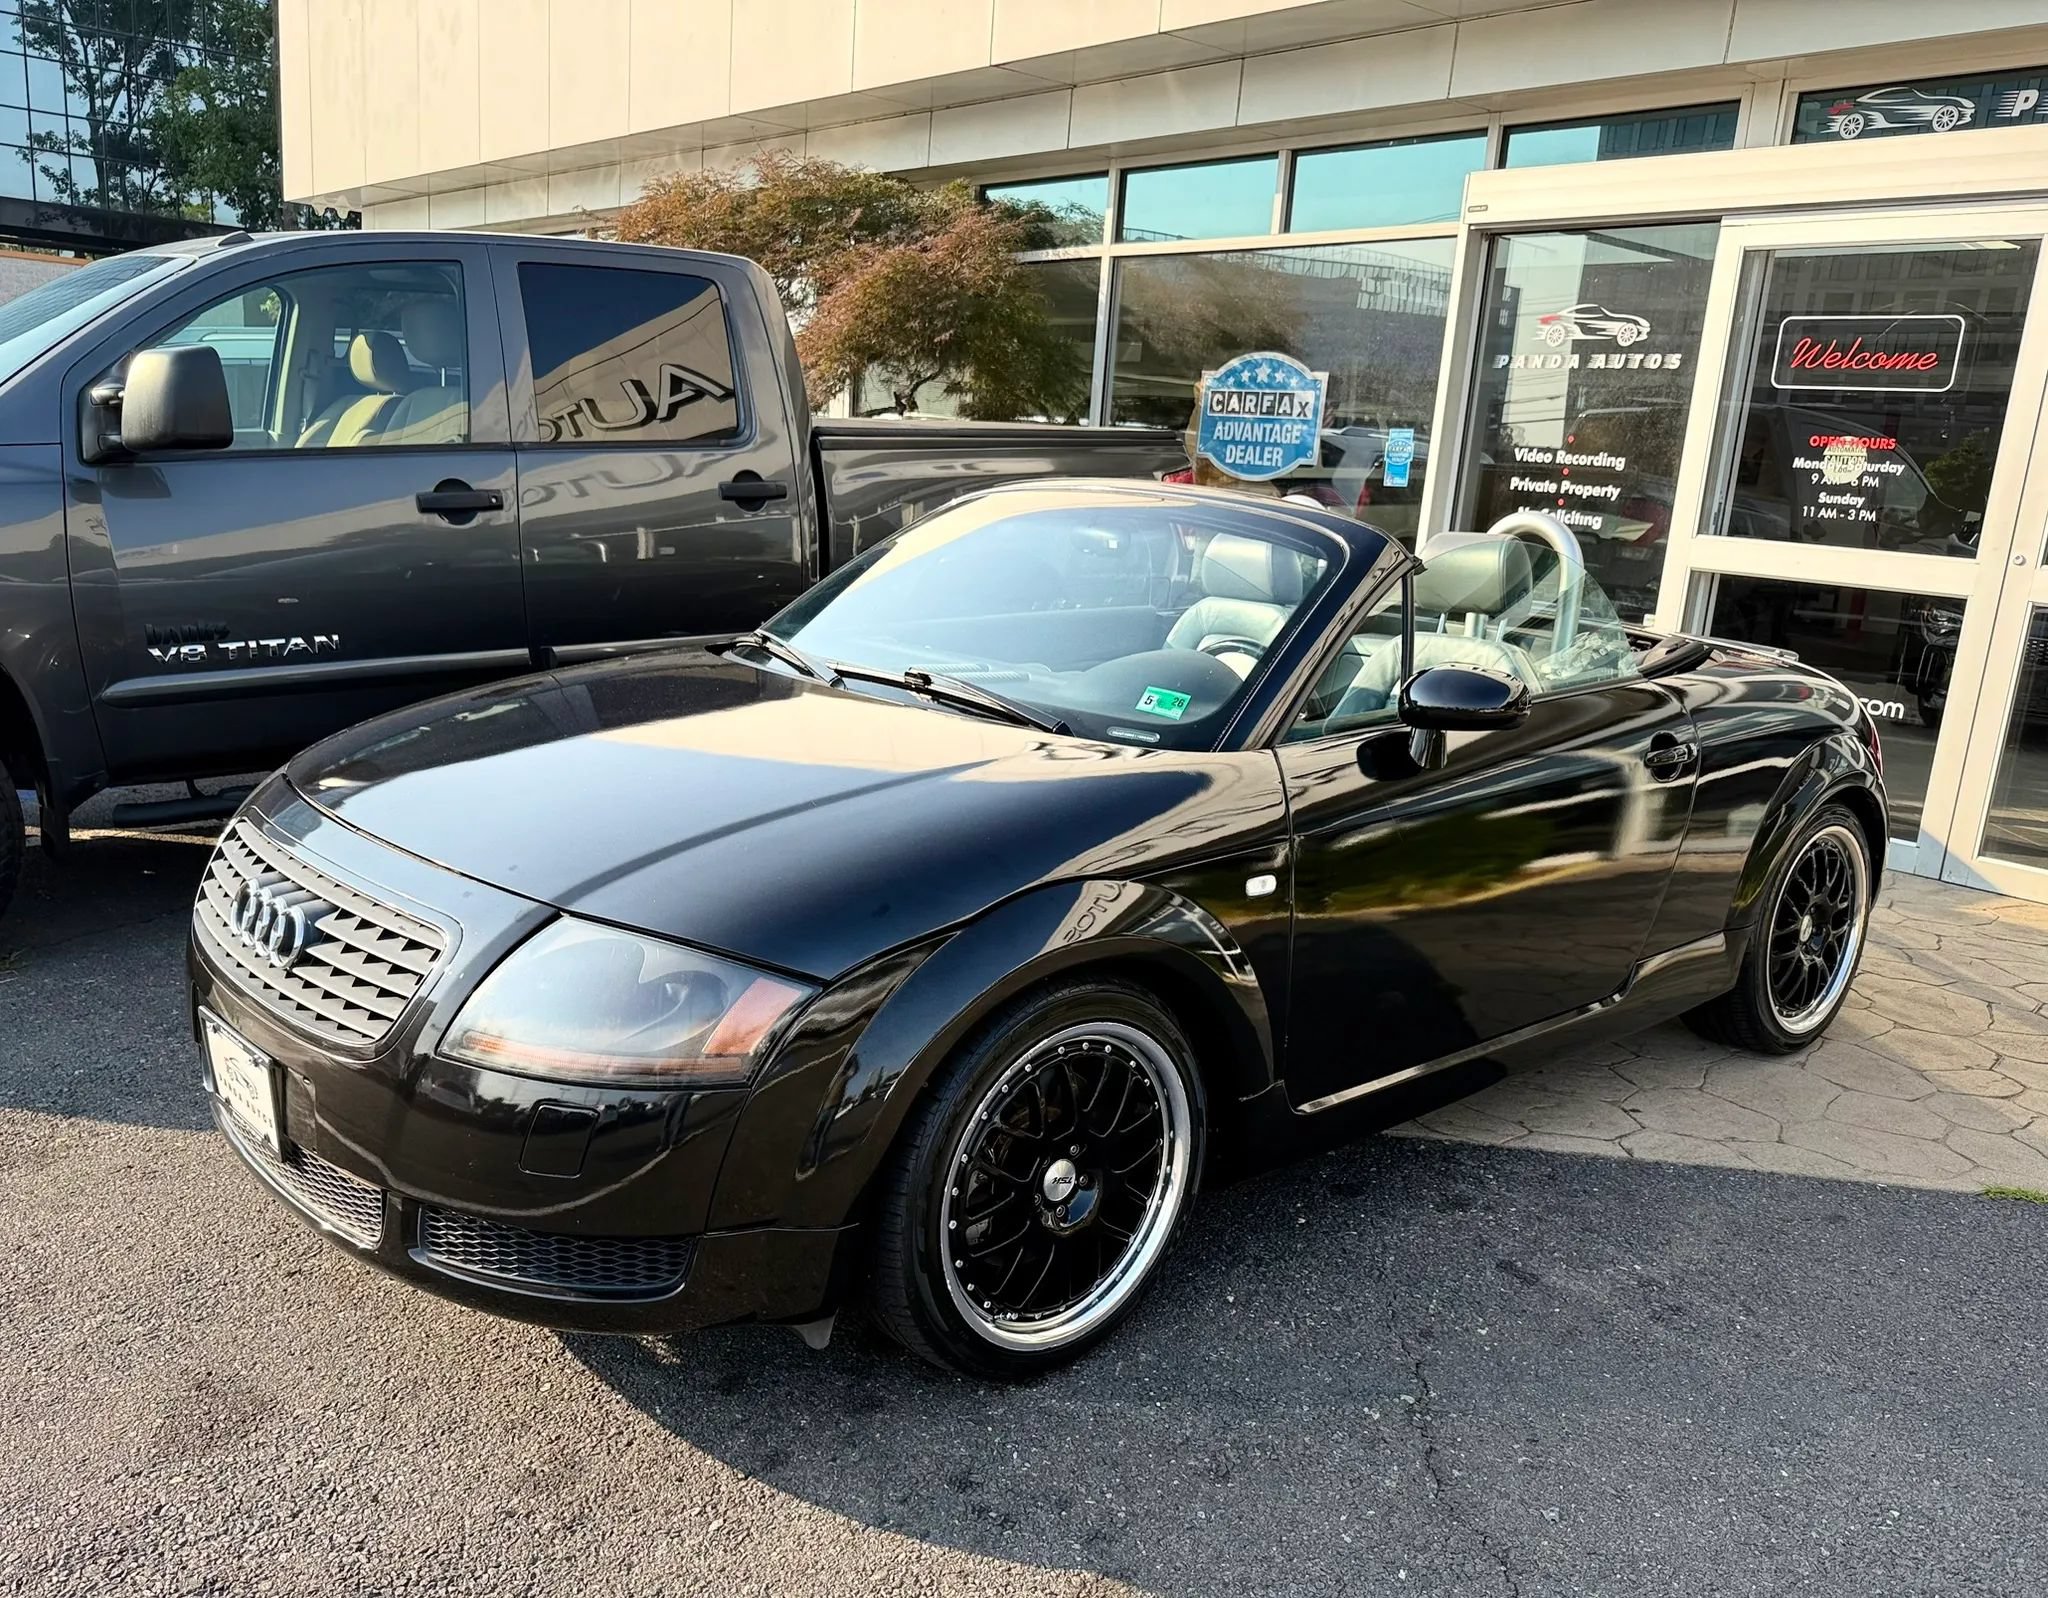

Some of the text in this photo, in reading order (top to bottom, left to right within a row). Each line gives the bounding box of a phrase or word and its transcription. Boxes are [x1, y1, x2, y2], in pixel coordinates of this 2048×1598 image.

[1492, 353, 1682, 369] PANDA AUTOS
[1790, 336, 1939, 370] Welcome
[1211, 391, 1311, 418] CARFAX
[1213, 421, 1302, 444] ADVANTAGE
[1809, 435, 1896, 450] OPEN HOURS
[1225, 444, 1284, 467] DEALER
[1514, 447, 1626, 471] Video Recording
[1510, 476, 1621, 501] Private Property
[1811, 473, 1819, 485] 9
[1862, 476, 1879, 488] PM
[1818, 492, 1865, 508] Sunday
[1802, 506, 1815, 517] 11
[1818, 507, 1837, 519] AM
[1848, 509, 1856, 520] 3
[1858, 509, 1877, 521] PM
[148, 635, 340, 664] V8 TITAN
